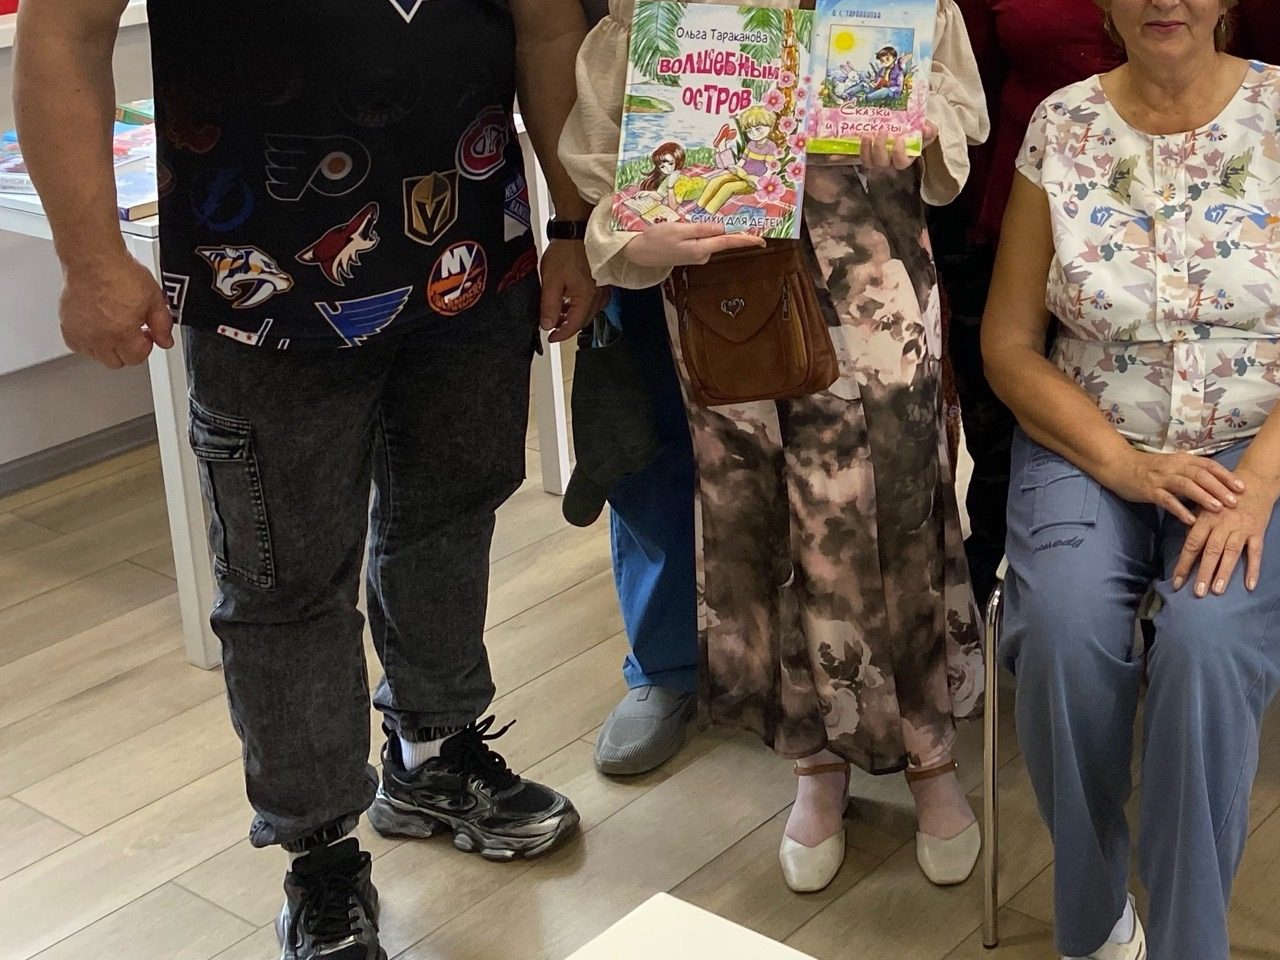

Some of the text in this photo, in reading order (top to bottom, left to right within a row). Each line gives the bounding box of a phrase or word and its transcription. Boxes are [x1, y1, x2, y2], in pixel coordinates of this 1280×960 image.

[676, 27, 768, 44] Ольга Тараканова
[682, 85, 751, 115] ОСТРОВ
[726, 216, 748, 226] ДЛЯ
